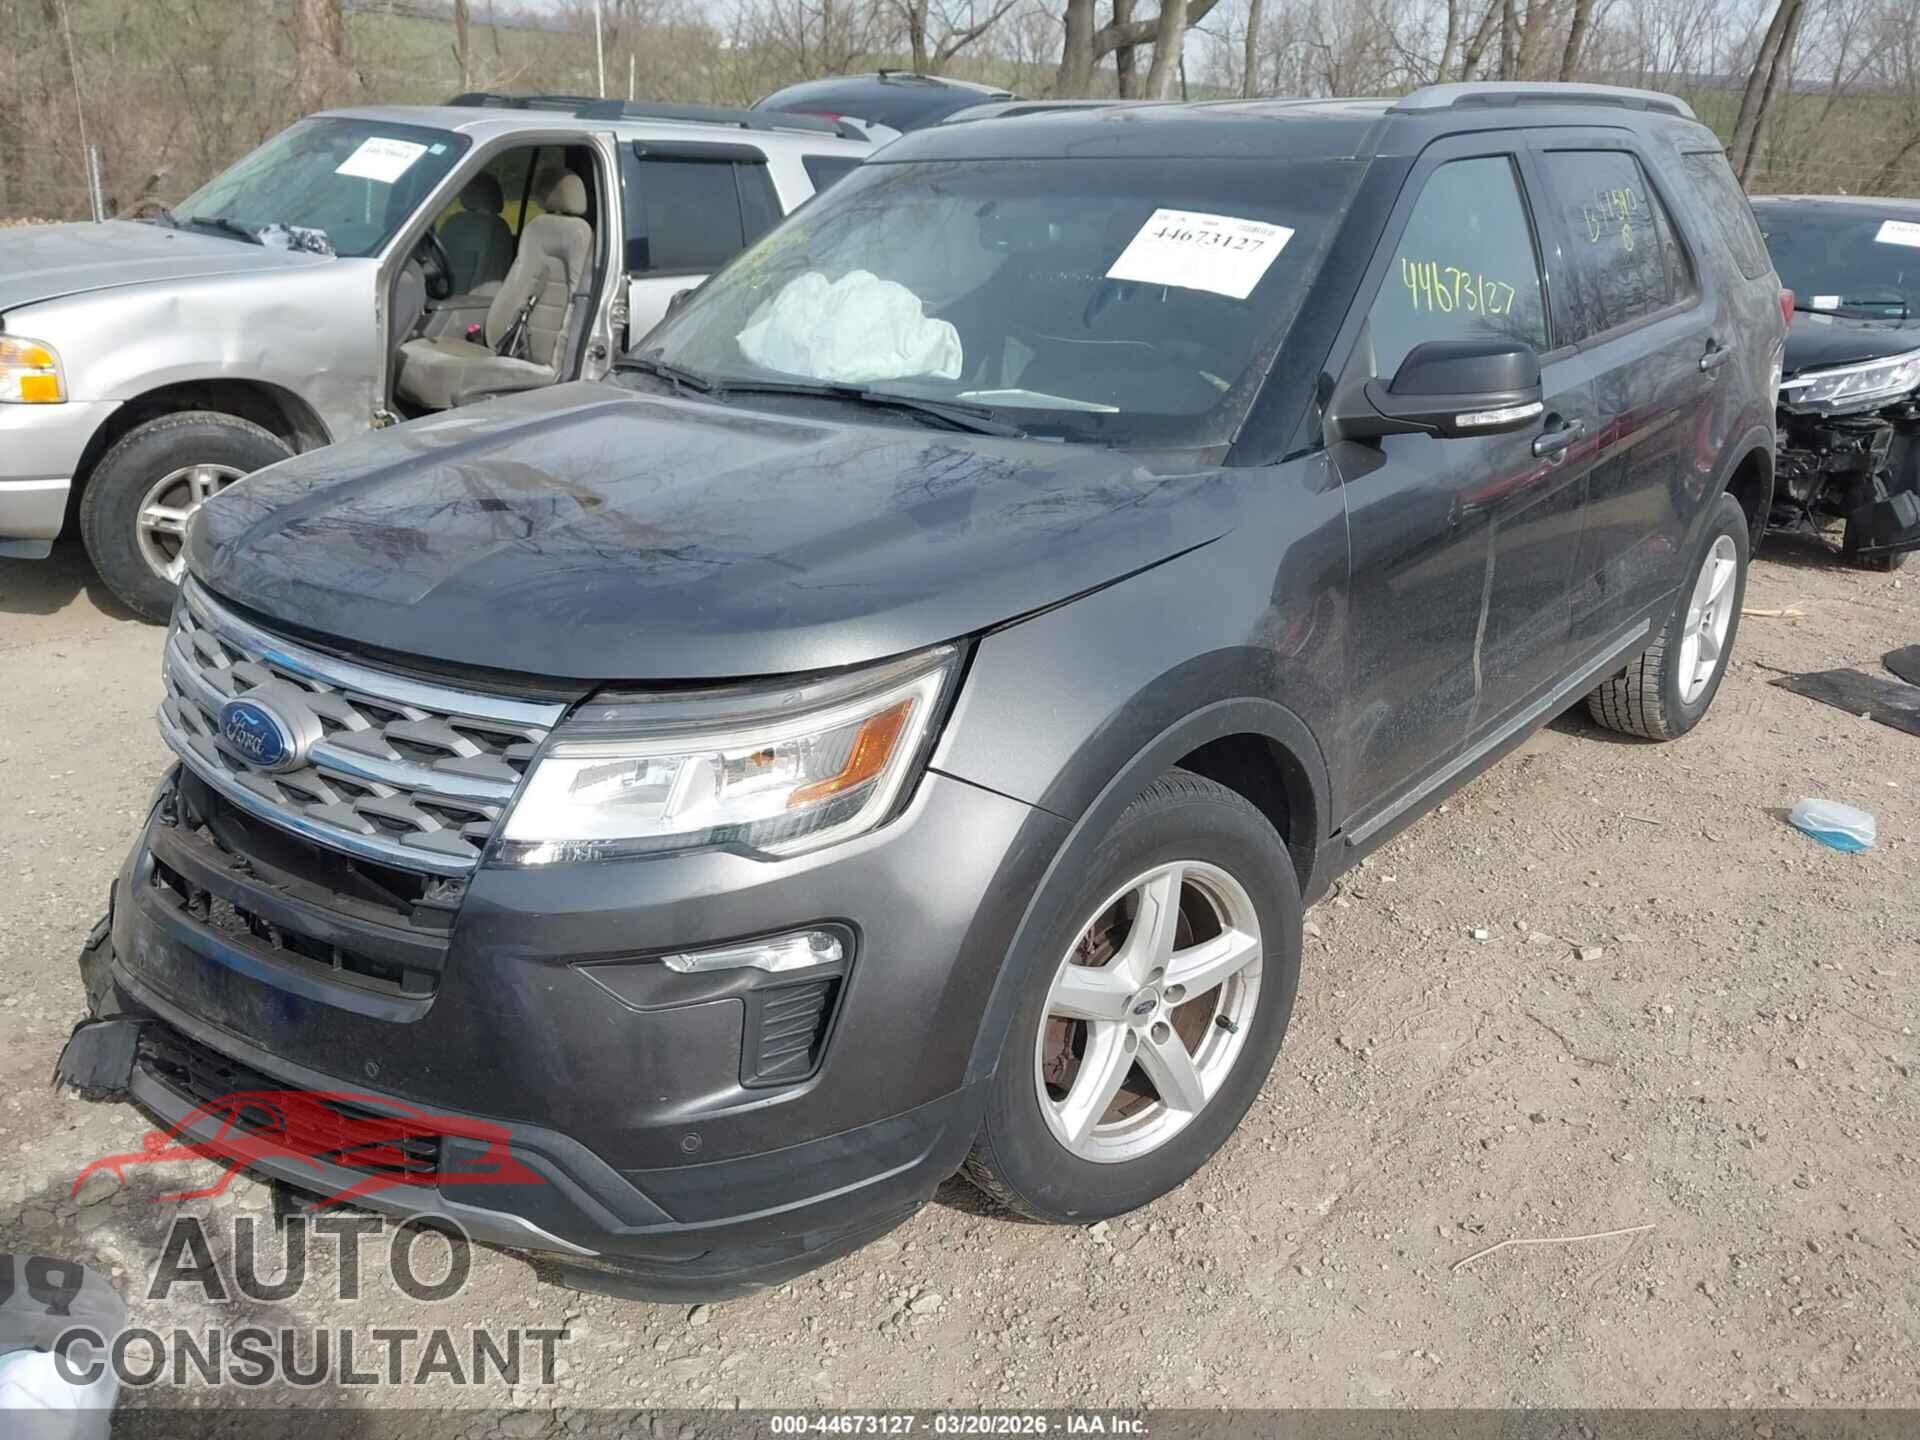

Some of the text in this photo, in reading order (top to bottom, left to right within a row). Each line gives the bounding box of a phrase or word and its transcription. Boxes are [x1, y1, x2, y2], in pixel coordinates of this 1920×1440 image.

[1153, 226, 1266, 253] 44673127
[1401, 257, 1516, 315] 44673127
[225, 709, 267, 754] Ford
